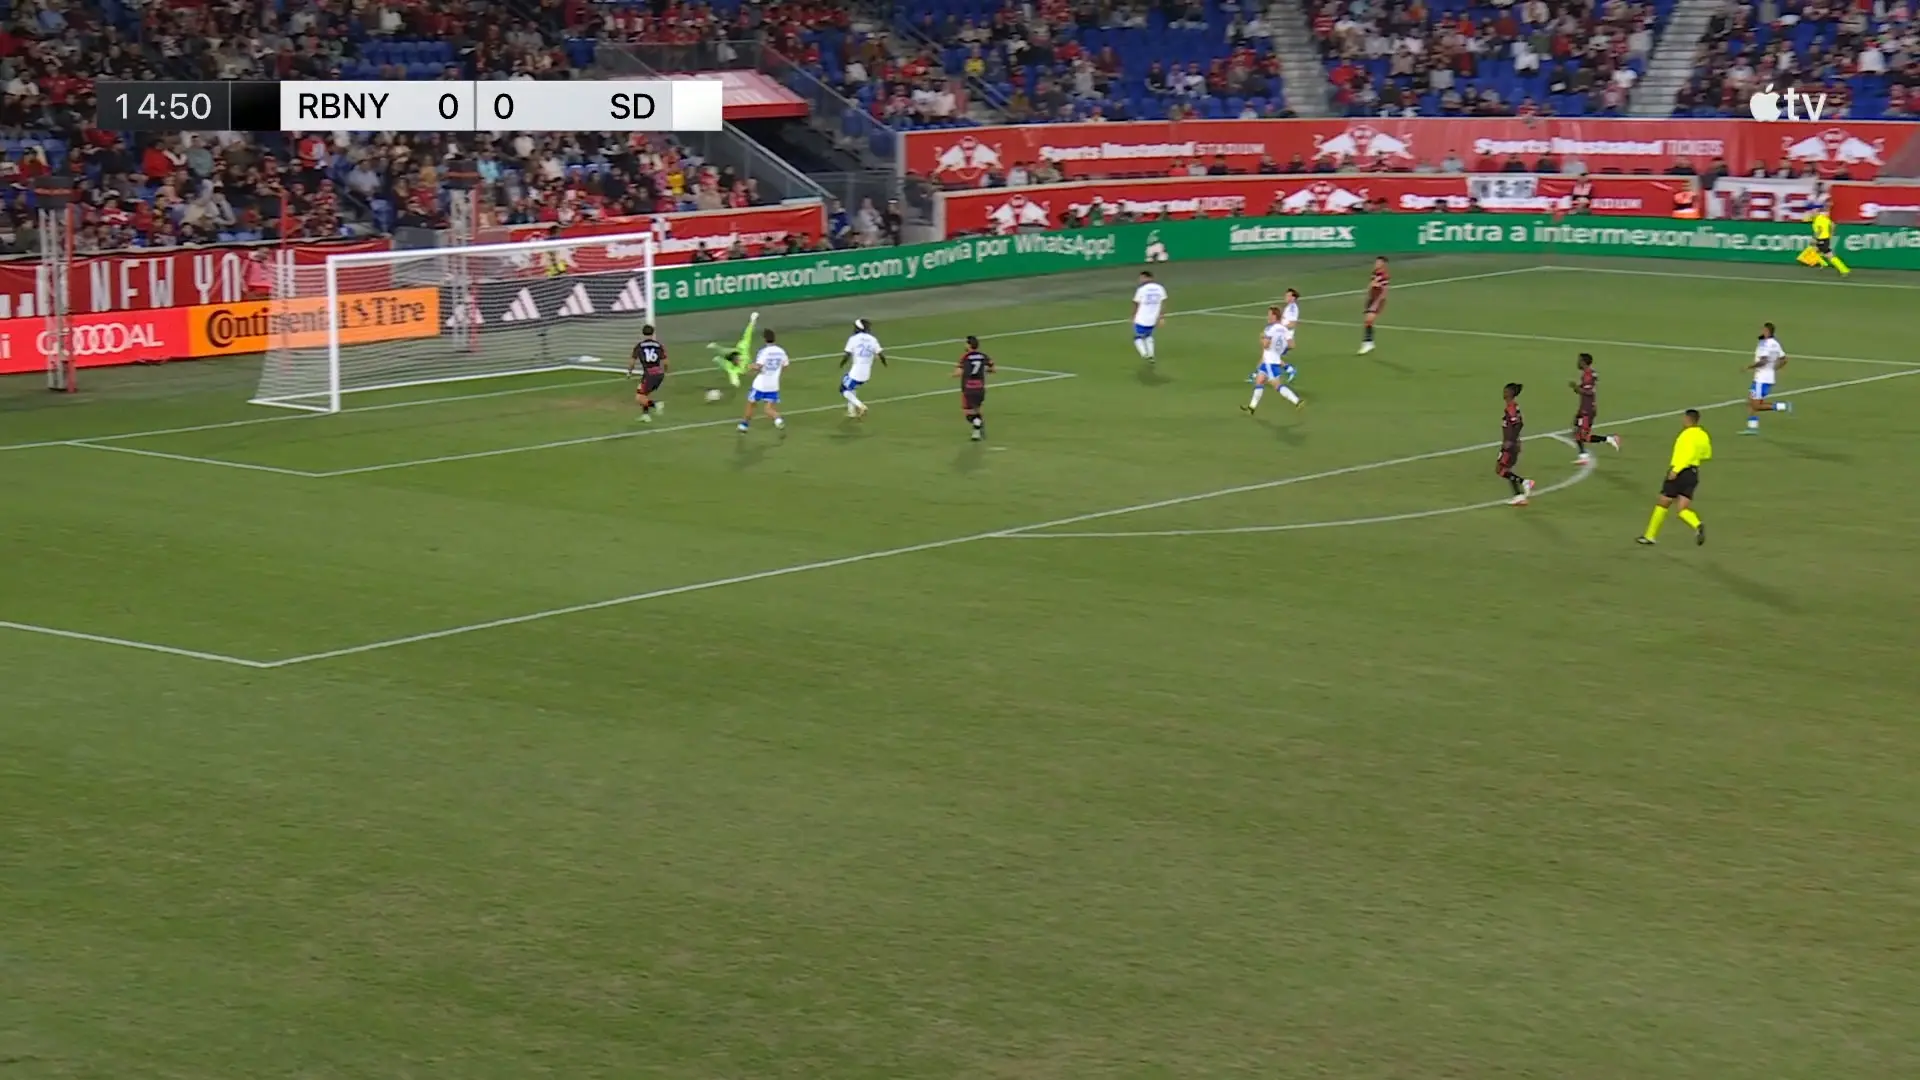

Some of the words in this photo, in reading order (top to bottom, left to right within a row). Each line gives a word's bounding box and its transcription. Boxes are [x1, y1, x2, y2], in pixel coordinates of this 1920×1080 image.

[1229, 224, 1357, 244] intermex
[1510, 224, 1528, 242] a
[1533, 220, 1815, 251] intermexonline.com
[675, 279, 689, 299] a
[693, 257, 903, 297] intermexonline.com
[905, 255, 920, 279] y
[975, 238, 1011, 264] por
[1013, 232, 1116, 262] WhatsApp!
[371, 296, 427, 326] Tire
[643, 347, 659, 363] 16
[969, 360, 983, 375] 7
